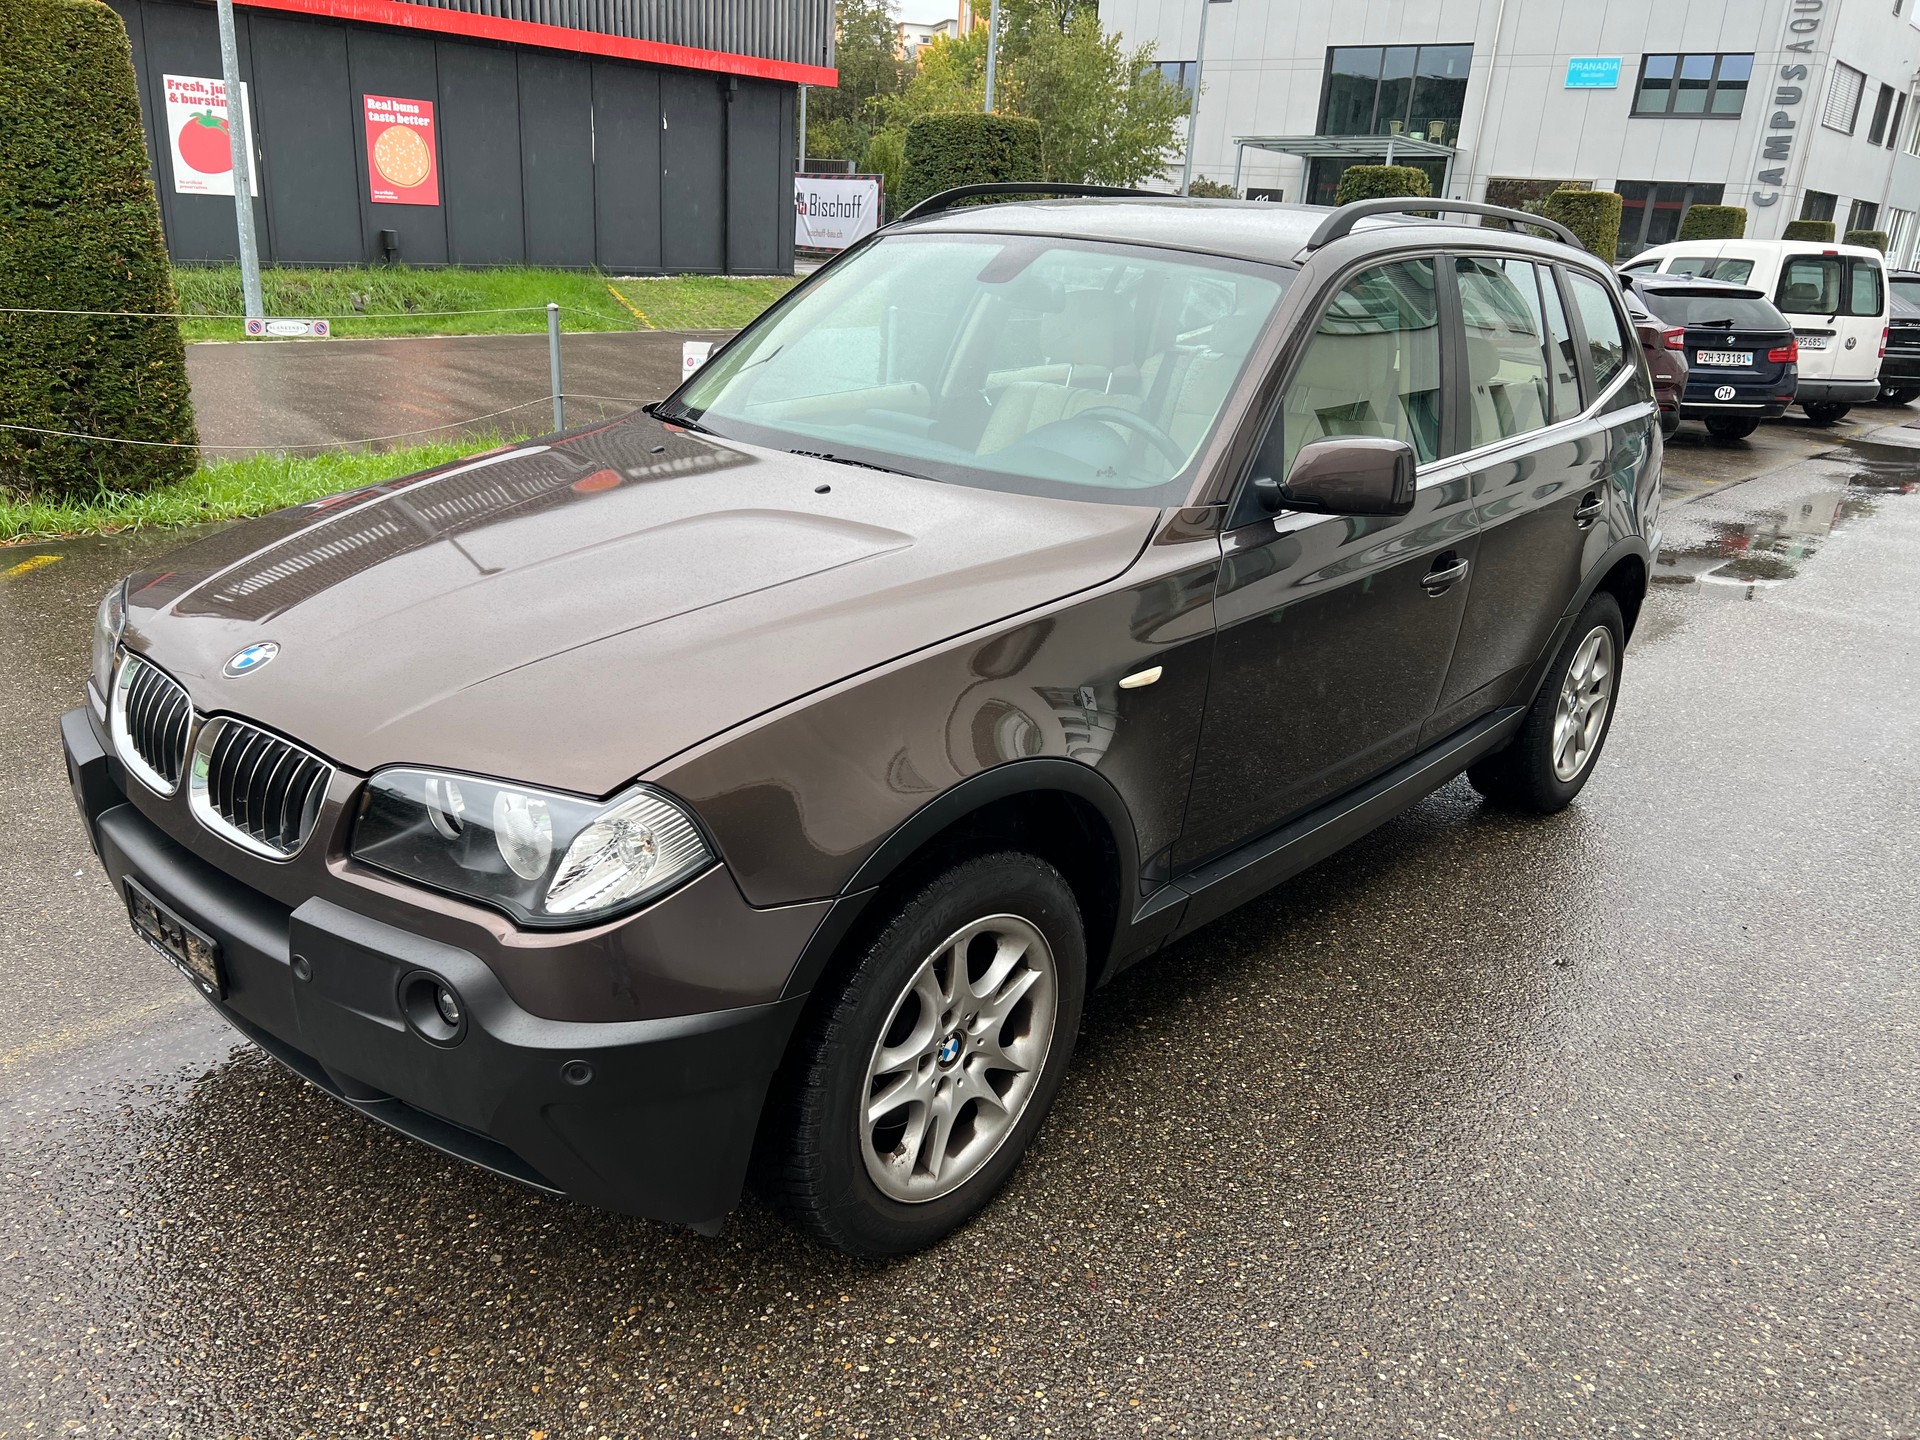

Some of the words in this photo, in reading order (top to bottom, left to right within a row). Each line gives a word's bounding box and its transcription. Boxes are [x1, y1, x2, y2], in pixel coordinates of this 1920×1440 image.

[1570, 62, 1618, 71] PRANADIA
[167, 79, 209, 95] Fresh,
[169, 92, 179, 103] &
[180, 93, 228, 107] burstin
[367, 98, 392, 111] Real
[392, 100, 420, 114] buns
[368, 111, 396, 123] taste
[396, 113, 430, 126] better
[1752, 64, 1808, 207] CAMPUS
[809, 193, 862, 218] Bischoff
[1717, 387, 1732, 399] CH
